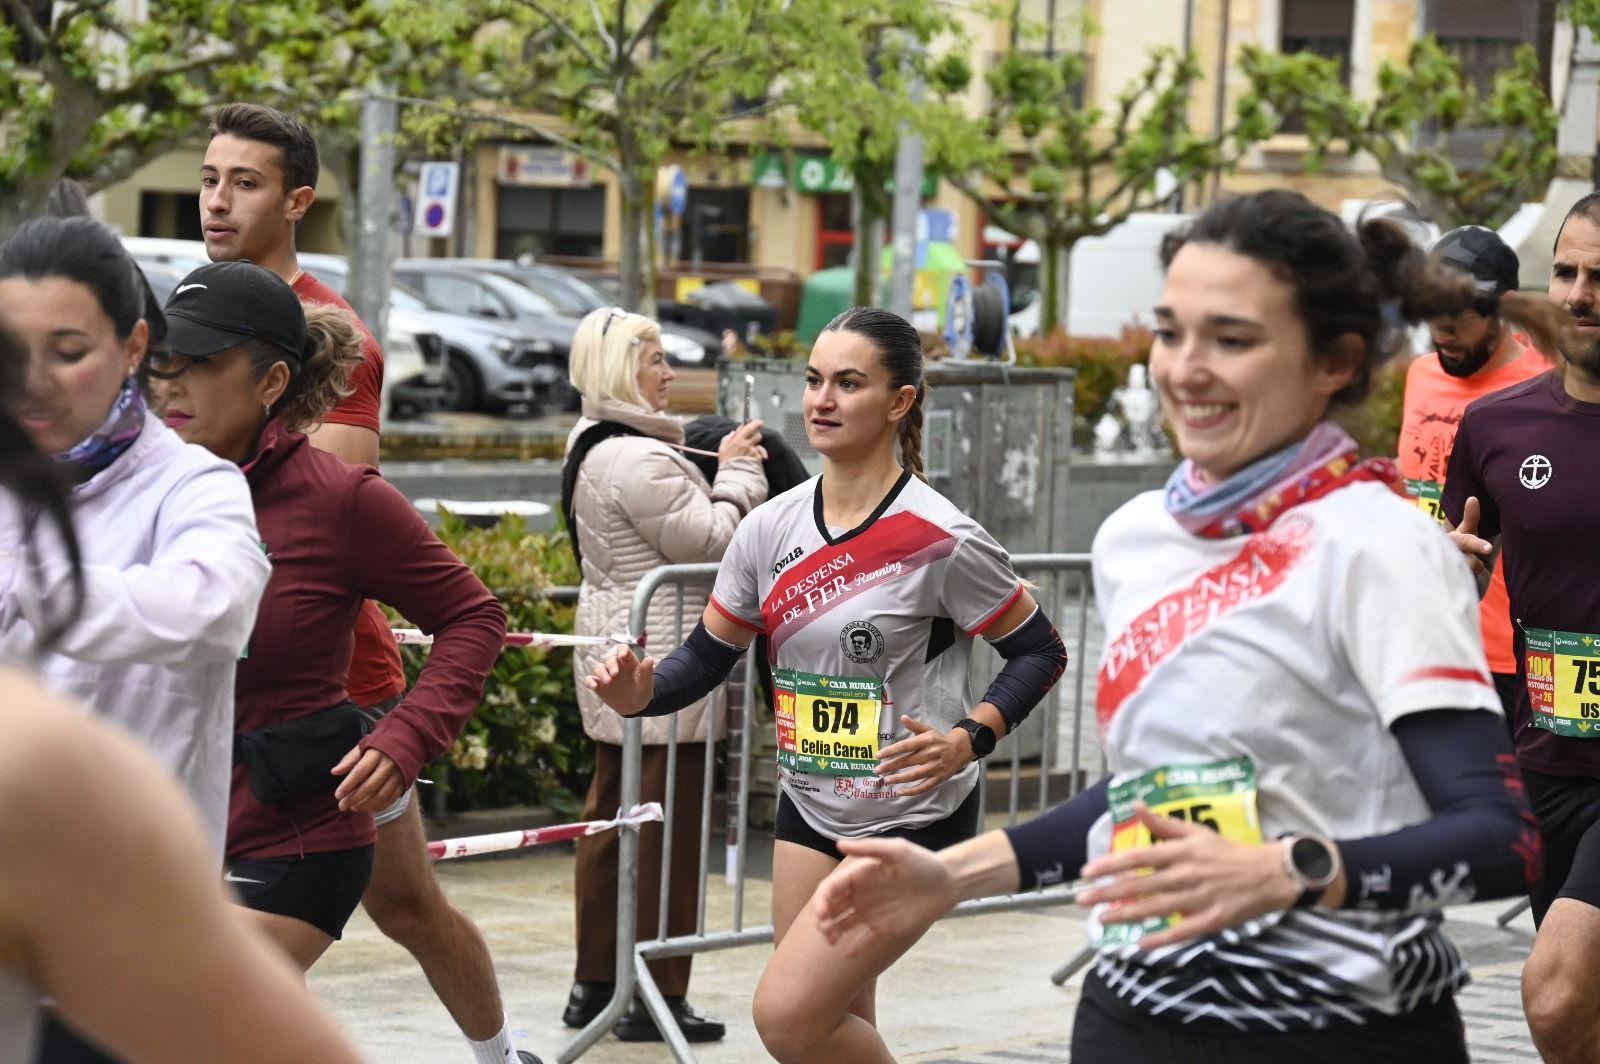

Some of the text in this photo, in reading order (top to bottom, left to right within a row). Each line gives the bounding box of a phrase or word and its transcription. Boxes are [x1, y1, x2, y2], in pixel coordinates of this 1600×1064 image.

[771, 552, 855, 613] LA DESPENSA
[854, 561, 903, 586] Running
[782, 575, 853, 625] DE FER
[1104, 553, 1271, 683] DESPENSA
[1528, 655, 1552, 676] 10K
[829, 681, 877, 690] CAJA RURAL
[1528, 681, 1554, 691] ASTORGA
[777, 693, 795, 714] 10K
[1543, 691, 1552, 702] 26
[812, 699, 860, 735] 674
[801, 738, 831, 756] Celia
[833, 741, 873, 759] Carral
[830, 761, 849, 769] CAJA
